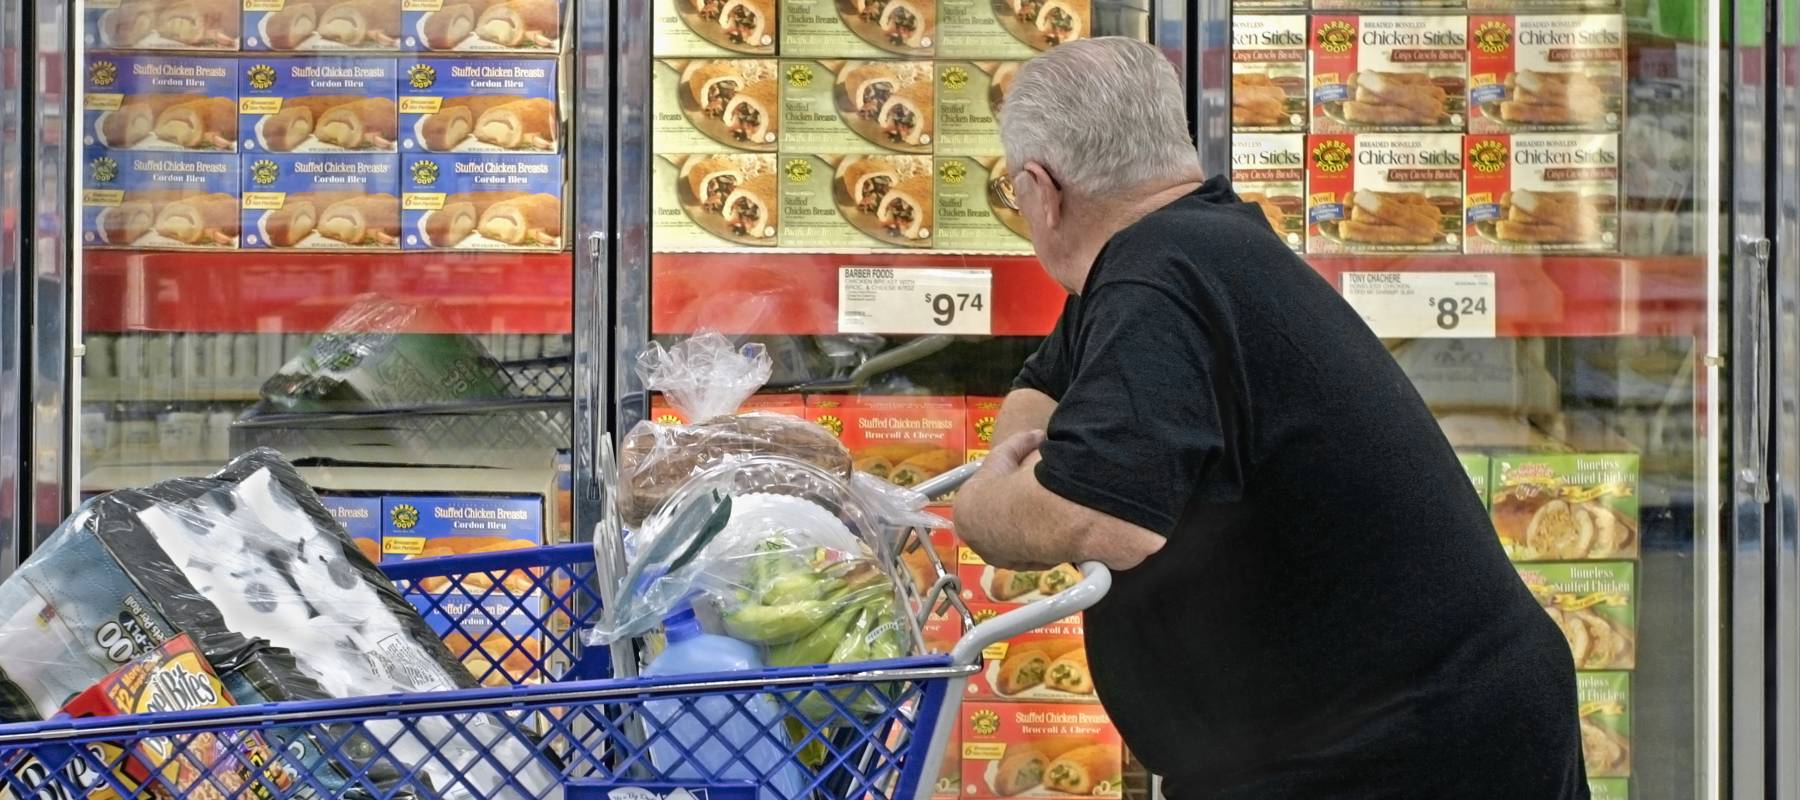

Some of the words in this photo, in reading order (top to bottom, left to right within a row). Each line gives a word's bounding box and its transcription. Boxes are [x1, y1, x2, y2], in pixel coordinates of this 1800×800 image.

[1317, 21, 1355, 34] BARBER
[1475, 21, 1512, 35] BARBER
[1262, 30, 1303, 45] Sticks
[1362, 30, 1420, 45] Chicken
[1423, 30, 1465, 46] Sticks
[1519, 30, 1575, 45] Chicken
[1578, 29, 1619, 45] Sticks
[1320, 42, 1353, 53] FOODS
[1477, 43, 1510, 54] FOODS
[133, 64, 162, 77] Stuffed
[163, 64, 194, 78] Chicken
[196, 67, 226, 78] Breasts
[291, 66, 320, 78] Stuffed
[321, 66, 352, 78] Chicken
[354, 67, 385, 78] Breasts
[451, 66, 480, 78] Stuffed
[481, 67, 513, 78] Chicken
[515, 67, 545, 78] Breasts
[311, 80, 341, 88] Cordon
[344, 80, 364, 88] Bleu
[471, 80, 501, 88] Cordon
[504, 80, 524, 88] Bleu
[1313, 140, 1352, 154] BARBER
[1469, 141, 1508, 155] BARBER
[1259, 149, 1301, 165] Sticks
[1358, 150, 1415, 165] Chicken
[1419, 150, 1460, 165] Sticks
[1515, 149, 1571, 165] Chicken
[1574, 148, 1615, 164] Sticks
[134, 160, 162, 172] Stuffed
[163, 160, 195, 172] Chicken
[196, 161, 226, 172] Breasts
[294, 161, 323, 173] Stuffed
[324, 162, 355, 173] Chicken
[357, 163, 388, 174] Breasts
[455, 162, 484, 173] Stuffed
[485, 162, 517, 174] Chicken
[518, 163, 549, 174] Breasts
[1316, 161, 1350, 173] FOODS
[1472, 162, 1506, 173] FOODS
[313, 176, 345, 184] Cordon
[347, 176, 367, 185] Bleu
[474, 175, 505, 184] Cordon
[507, 175, 529, 184] Bleu
[784, 207, 812, 216] Chicken
[813, 207, 836, 216] Breasts
[939, 208, 967, 217] Chicken
[967, 209, 991, 218] Breasts
[845, 269, 871, 279] BARBER
[872, 269, 895, 280] FOODS
[858, 418, 887, 430] Stuffed
[888, 419, 920, 431] Chicken
[921, 419, 953, 430] Breasts
[864, 431, 901, 440] Broccoli
[903, 431, 912, 440] &
[913, 431, 945, 440] Cheese
[1576, 458, 1620, 471] Boneless
[1597, 471, 1634, 485] Chicken
[338, 507, 369, 519] Breasts
[434, 507, 463, 519] Stuffed
[464, 507, 496, 519] Chicken
[497, 508, 528, 520] Breasts
[453, 521, 485, 530] Cordon
[487, 521, 507, 530] Bleu
[1570, 567, 1615, 578] Boneless
[1591, 579, 1630, 592] Chicken
[124, 595, 144, 614] Roll
[138, 610, 155, 629] Per
[96, 621, 139, 663] 00
[162, 663, 215, 712] Bites
[1015, 712, 1044, 724] Stuffed
[1046, 712, 1078, 724] Chicken
[1022, 725, 1059, 735] Broccoli
[1061, 726, 1068, 734] &
[1070, 725, 1102, 735] Cheese
